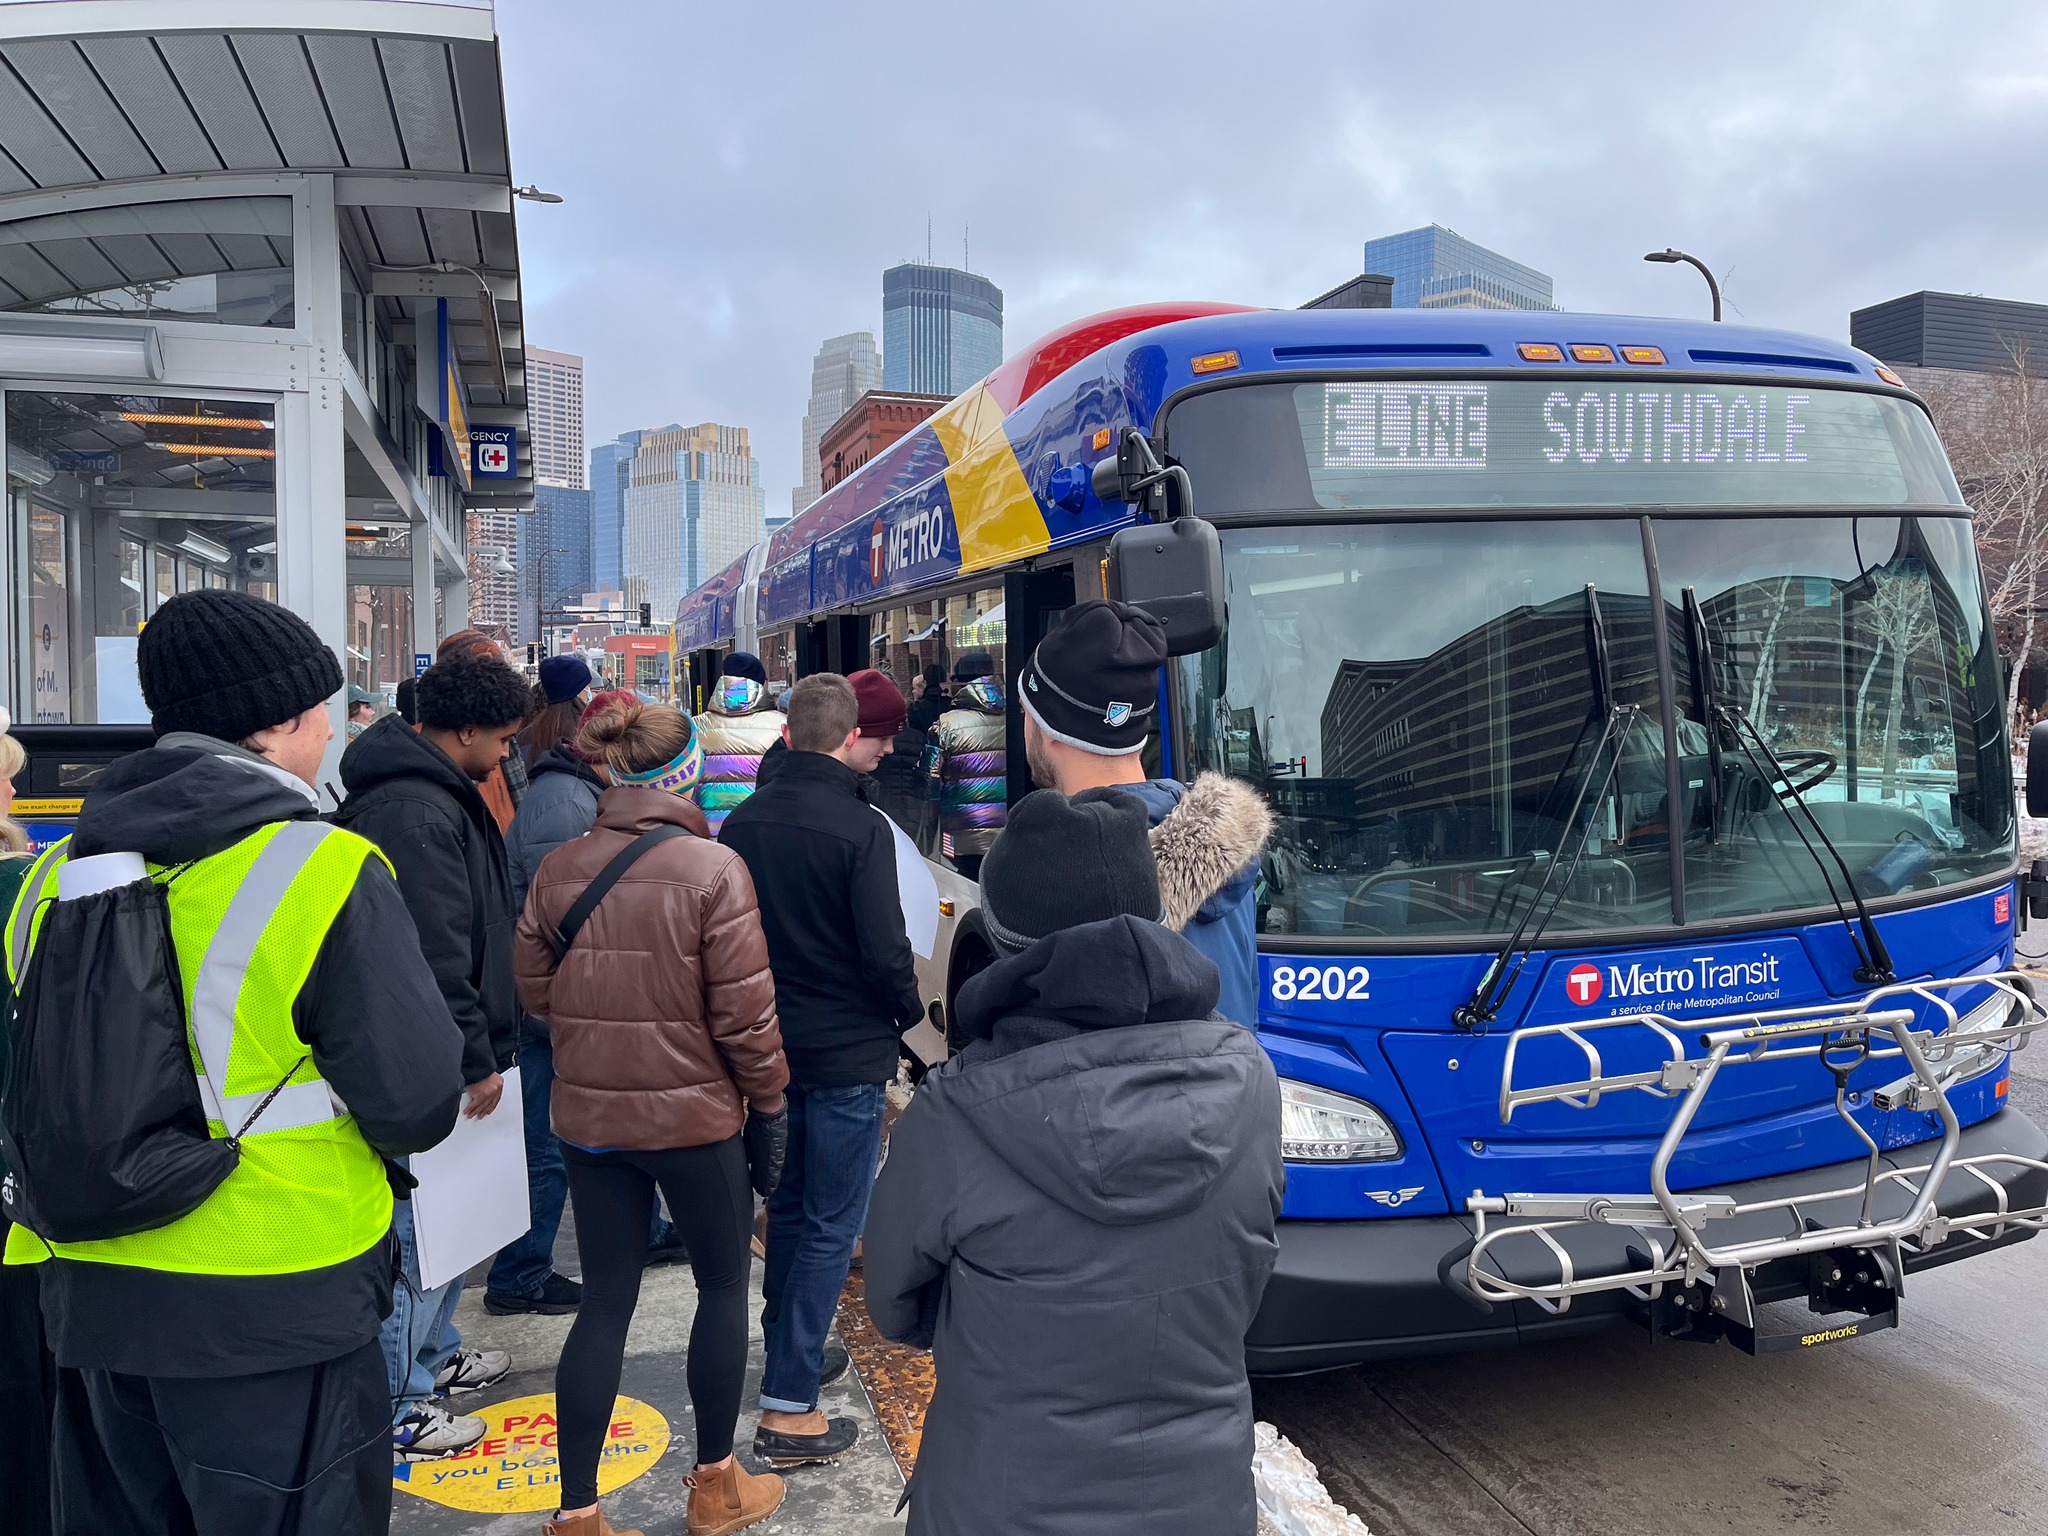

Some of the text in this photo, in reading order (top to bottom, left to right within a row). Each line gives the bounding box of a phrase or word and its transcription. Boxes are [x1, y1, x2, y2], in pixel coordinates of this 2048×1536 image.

[470, 431, 510, 442] GENCY
[1328, 391, 1810, 462] E LINE SOUTHDALE
[888, 505, 943, 574] METRO
[37, 669, 46, 692] of
[48, 803, 70, 811] change
[1271, 966, 1370, 1000] 8202
[1608, 963, 1694, 998] Metro
[1692, 952, 1780, 989] Transit
[1610, 989, 1780, 1016] a service of the Metropolitan Council
[1801, 1325, 1858, 1346] sportworks
[503, 1413, 557, 1432] PA
[432, 1465, 488, 1485] you
[501, 1457, 557, 1472] boa
[496, 1476, 514, 1490] E
